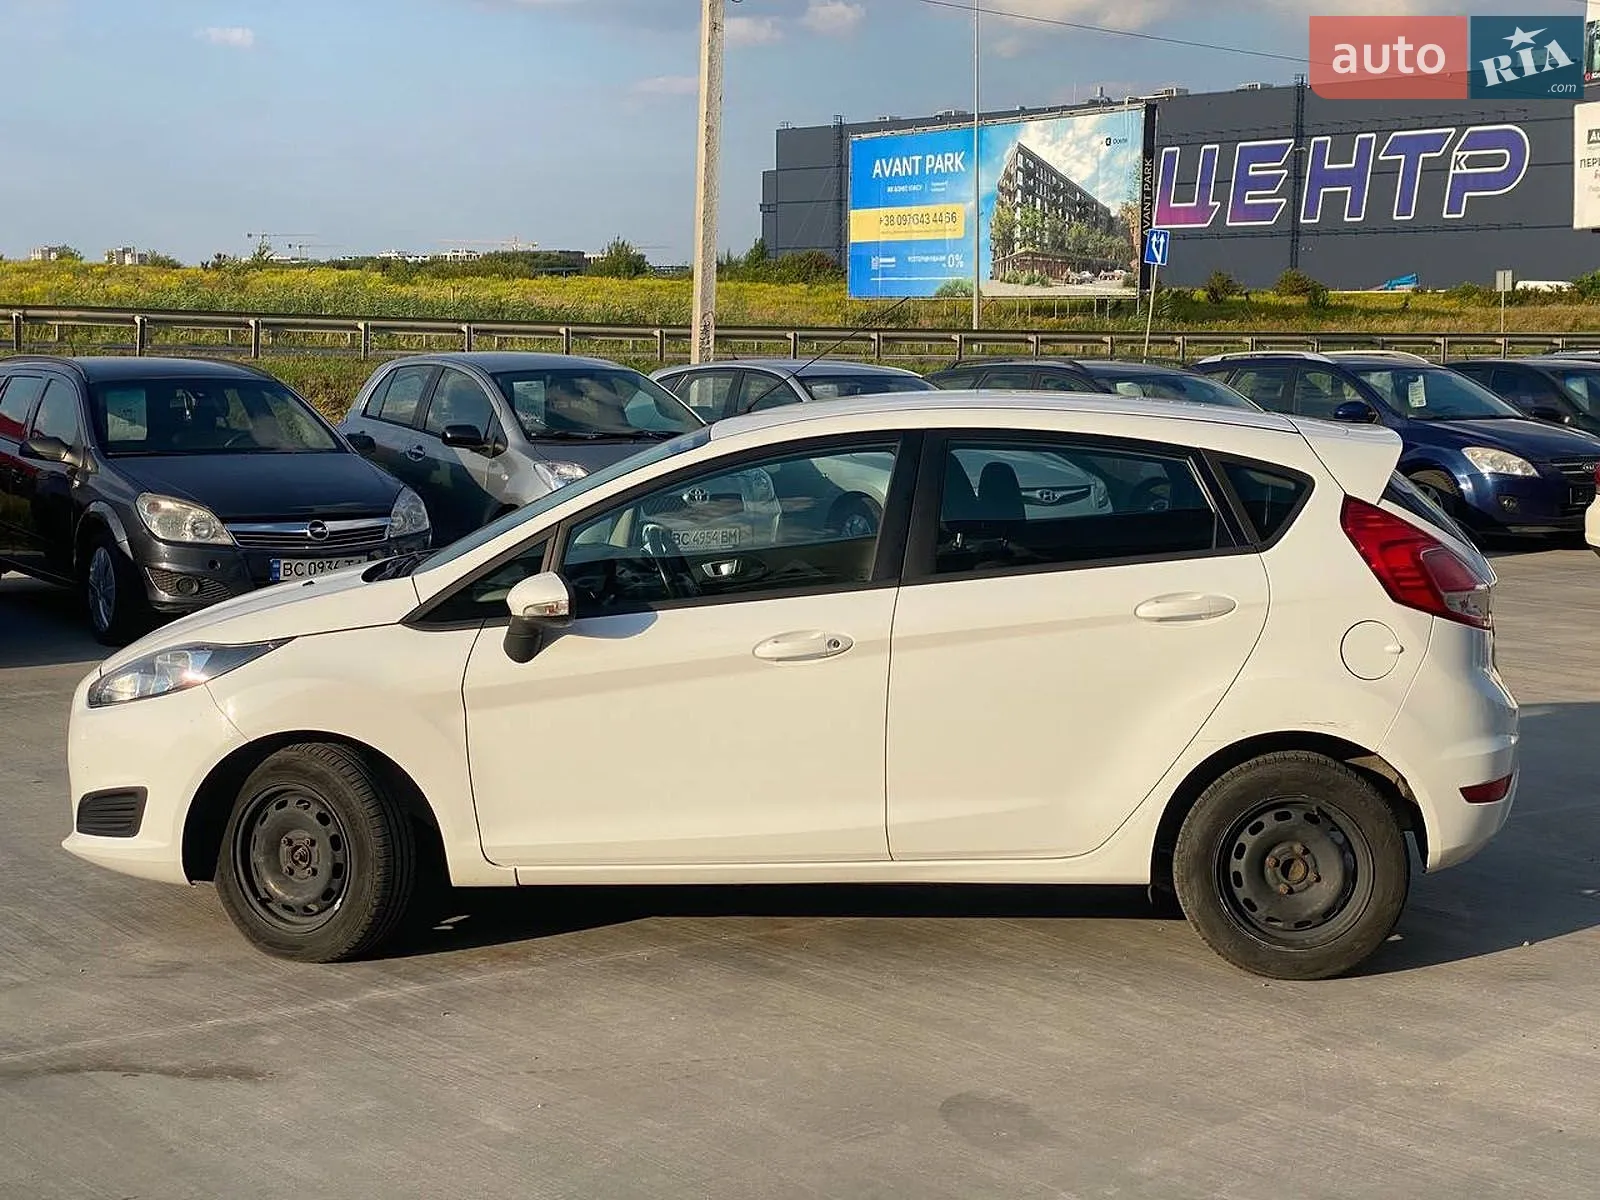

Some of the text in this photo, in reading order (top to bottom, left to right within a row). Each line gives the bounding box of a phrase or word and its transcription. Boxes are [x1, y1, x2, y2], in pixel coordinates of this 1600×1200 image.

[872, 151, 966, 179] AVANT PARK
[1143, 157, 1152, 191] PARK
[1153, 124, 1530, 228] ЦЕНТР
[947, 253, 964, 268] 0%
[283, 562, 304, 577] BC
